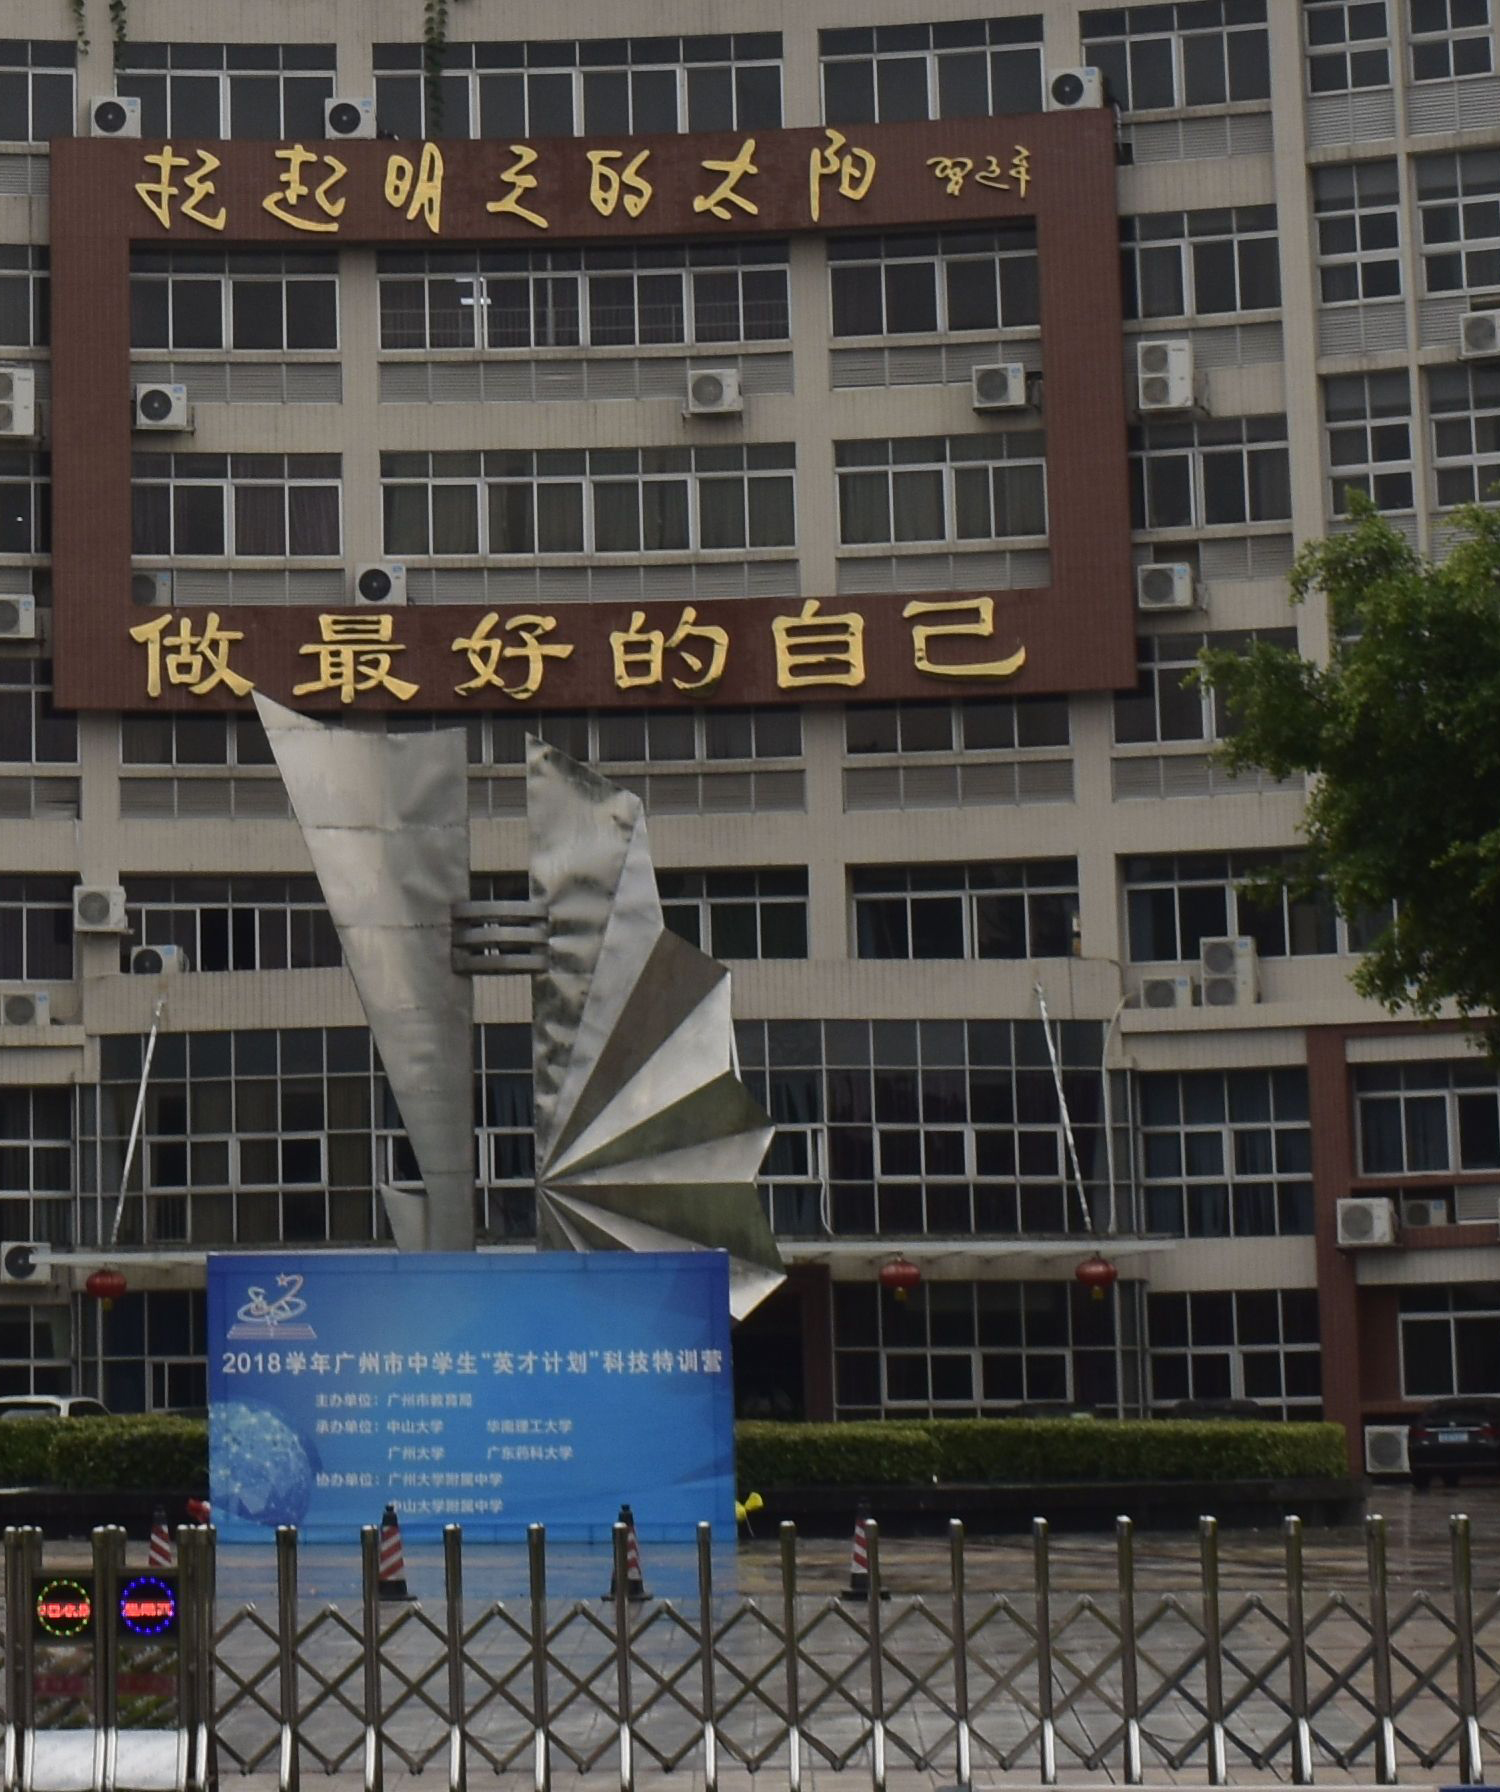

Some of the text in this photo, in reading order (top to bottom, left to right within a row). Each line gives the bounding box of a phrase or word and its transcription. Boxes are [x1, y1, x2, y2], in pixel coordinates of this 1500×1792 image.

[129, 598, 1027, 703] 做最好的自己
[486, 1419, 573, 1434] 华南理工大学
[387, 1445, 445, 1461] 广州大学
